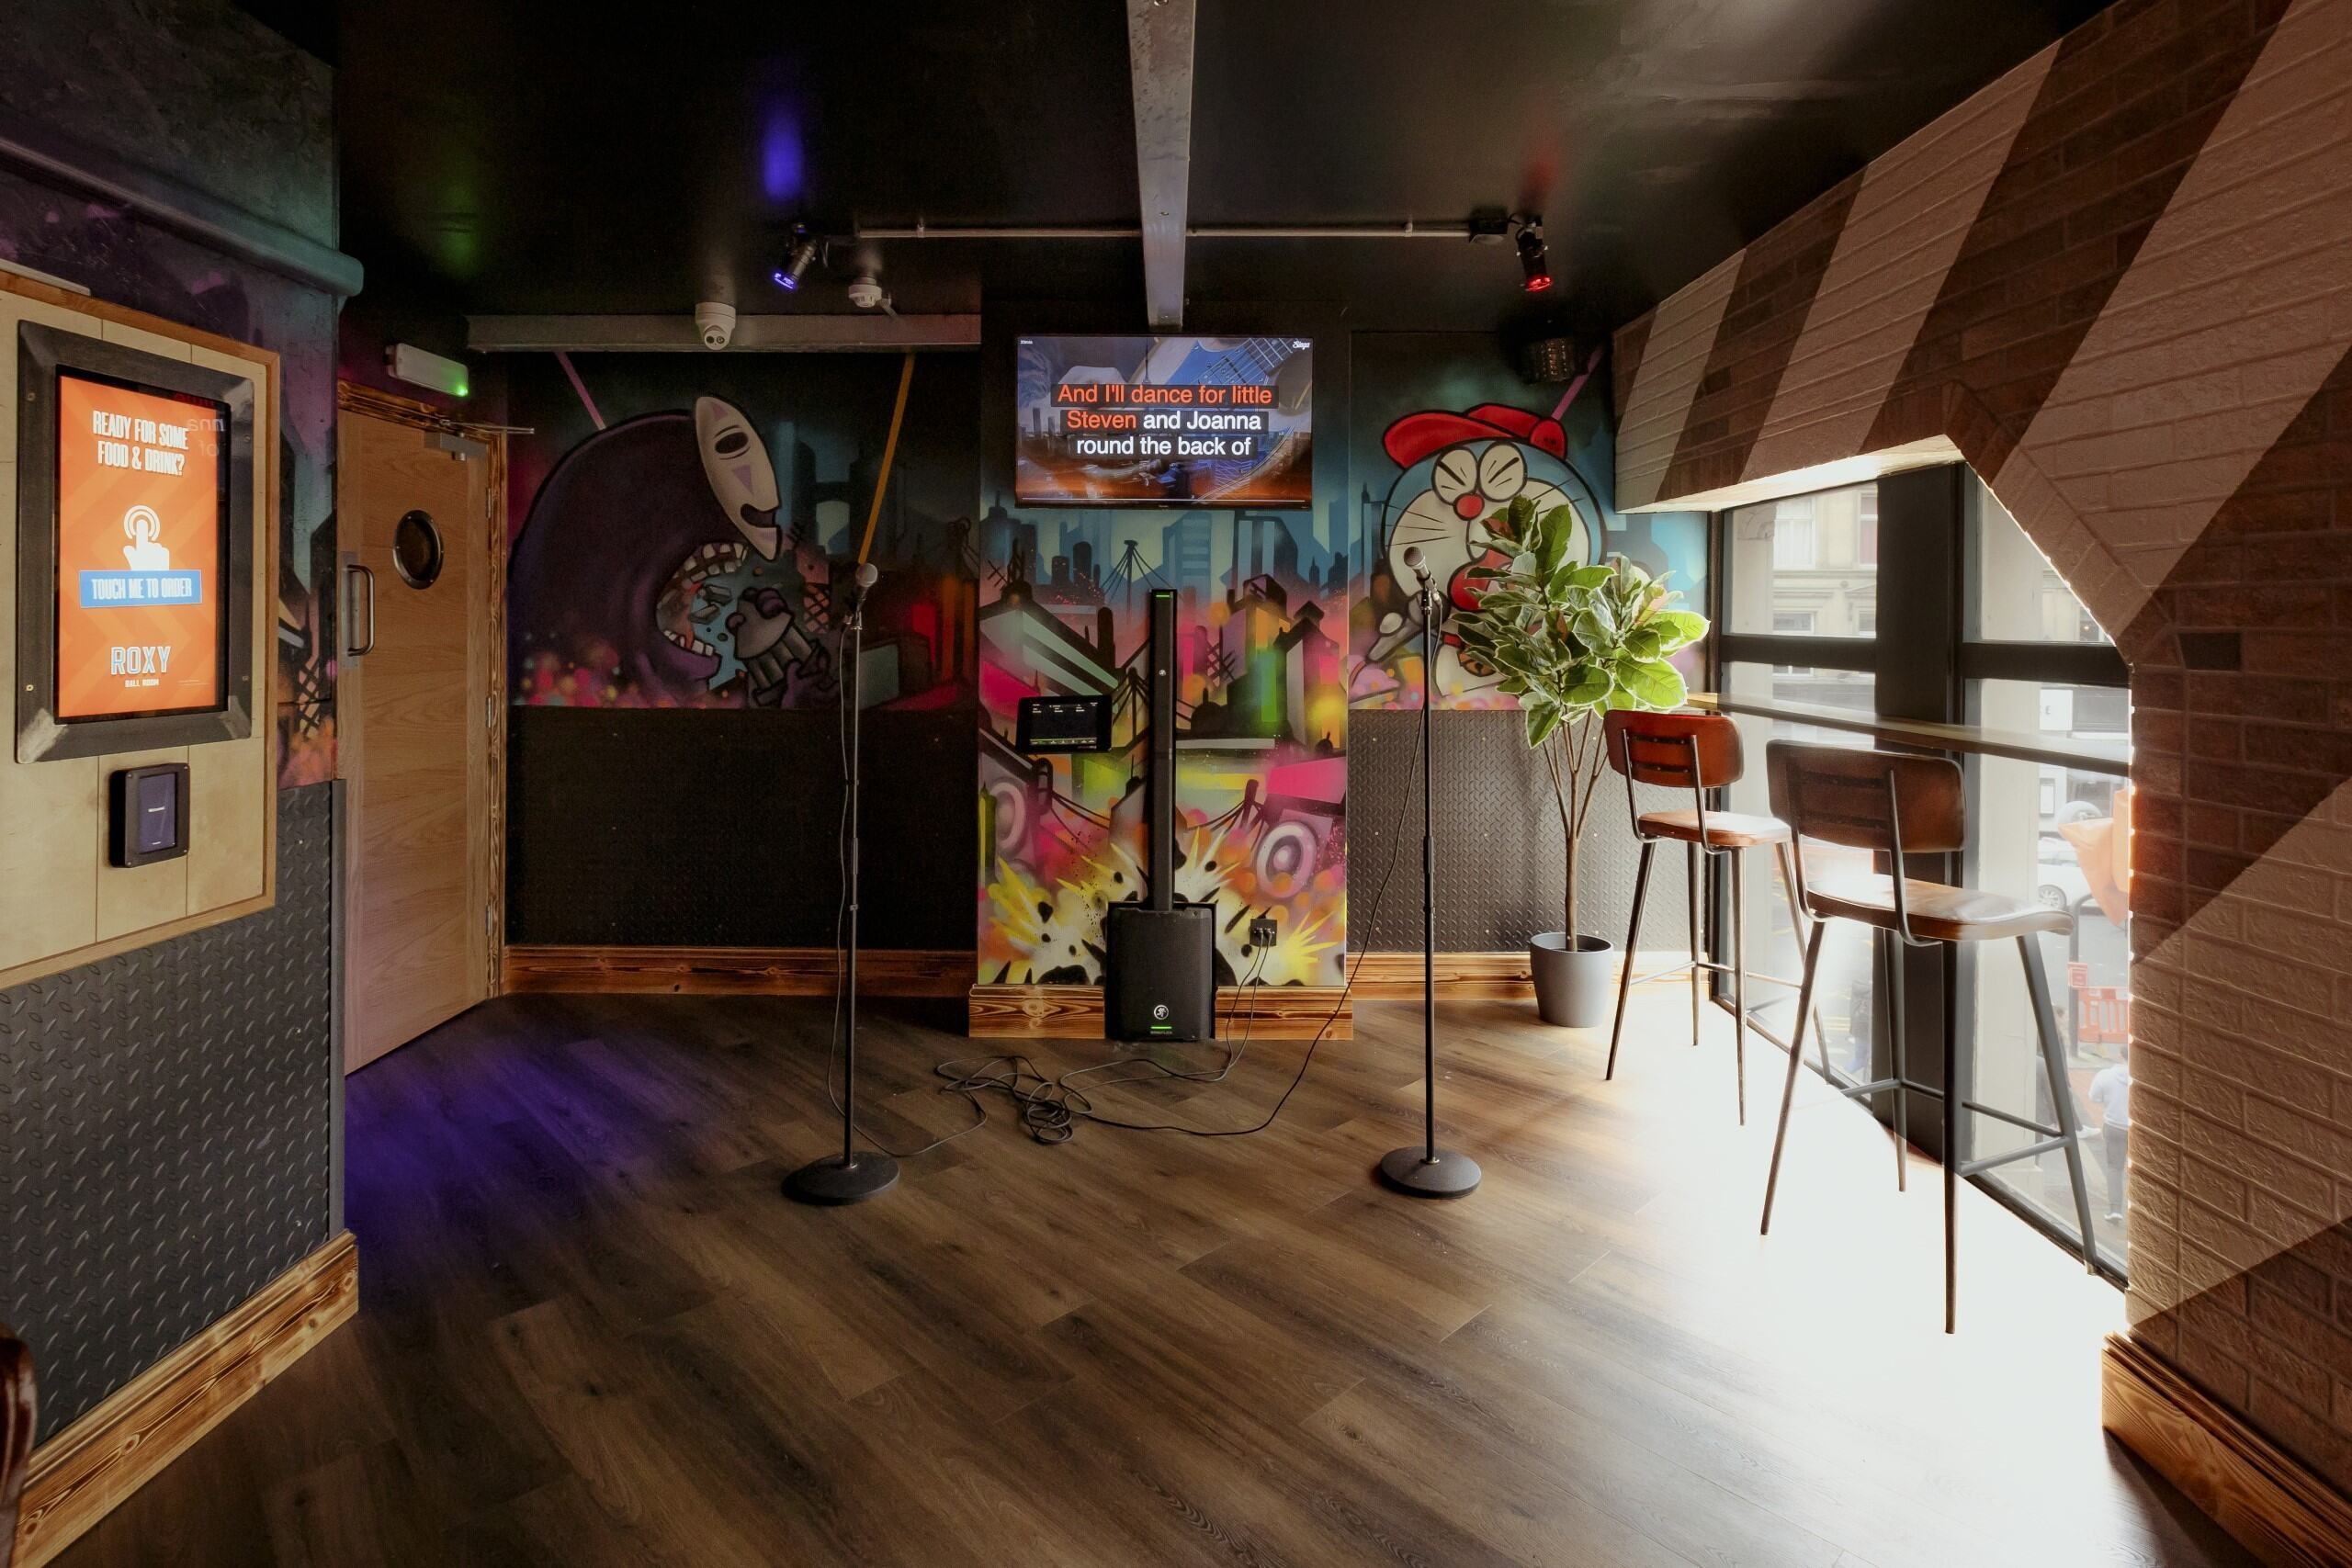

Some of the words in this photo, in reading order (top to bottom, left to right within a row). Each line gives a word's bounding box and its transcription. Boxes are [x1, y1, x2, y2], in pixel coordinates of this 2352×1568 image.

[1057, 383, 1098, 403] And
[1105, 383, 1125, 403] I'll
[1131, 384, 1193, 403] dance
[1199, 384, 1226, 403] for
[1232, 384, 1272, 404] little
[93, 410, 131, 440] READY
[134, 418, 156, 445] FOR
[158, 423, 189, 450] SOME
[1067, 410, 1136, 429] Steven
[1143, 410, 1181, 429] and
[1186, 411, 1261, 430] Joanna
[1077, 435, 1134, 455] round
[1139, 436, 1171, 455] the
[1178, 436, 1227, 456] back
[1231, 436, 1251, 456] of
[97, 440, 129, 468] FOOD
[131, 446, 141, 470] &
[144, 447, 185, 476] DRINK?
[91, 578, 126, 600] TOUCH
[129, 578, 144, 599] ME
[146, 577, 159, 598] TO
[110, 646, 171, 675] ROXY
